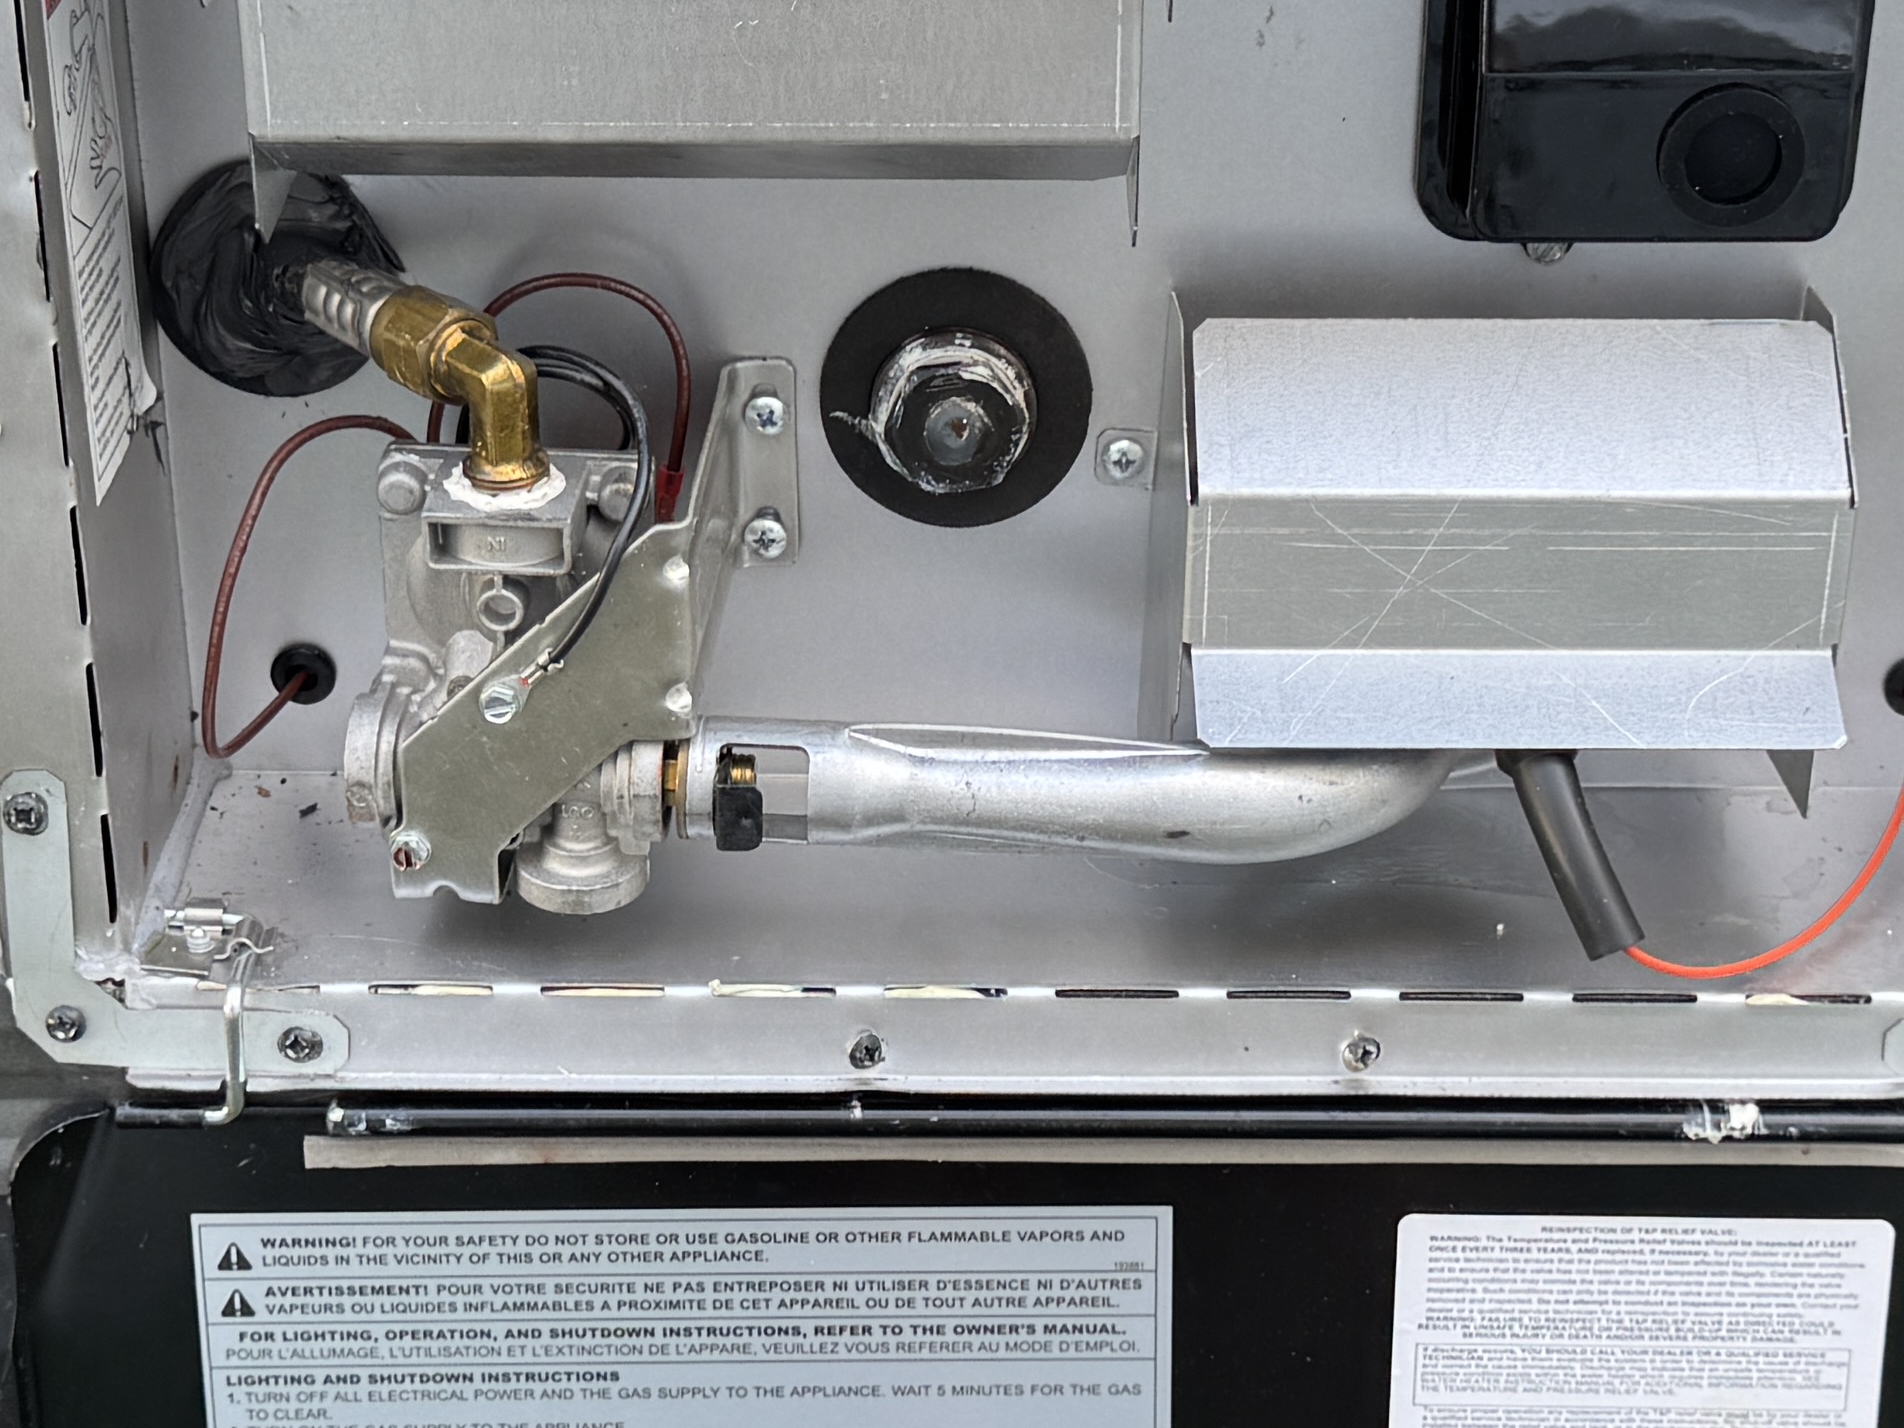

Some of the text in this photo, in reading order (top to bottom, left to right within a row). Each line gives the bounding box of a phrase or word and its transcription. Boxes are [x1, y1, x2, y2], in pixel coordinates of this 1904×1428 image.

[259, 1229, 1125, 1249] WARNING! FOR YOUR SAFETY DO NOT STORE OR USE GASOLINE OR OTHER FLAMMABLE VAPORS AND
[1540, 1226, 1737, 1236] REINSPECTION OF T&P RELIEF VALVE:
[261, 1249, 769, 1267] LIQUIDS IN THE VICINITY OF THIS OR ANY OTHER APPLIANCE.
[263, 1277, 1142, 1298] AVERTISSEMENT! POUR VOTRE SECURITE NE PAS ENTREPOSER NI UTILISER D'ESSENCE NI D'AUTRES
[264, 1295, 1120, 1315] VAPEURS OU LIQUIDES INFLAMMABLES A PROXIMITE DE CET APPAREIL OU DE TOUT AUTRE APPAREIL.
[237, 1322, 1126, 1344] FOR LIGHTING, OPERATION, AND SHUTDOWN INSTRUCTIONS, REFER TO THE OWNER'S MANUAL.
[224, 1339, 1140, 1361] POUR L'ALLUMAGE, L'UTILISATION ET L'EXTINCTION DE L'APPARE, VEUILLEZ VOUS REFERER AU MODE D'EMPLOI.
[224, 1370, 620, 1387] LIGHTING AND SHUTDOWN INSTRUCTIONS
